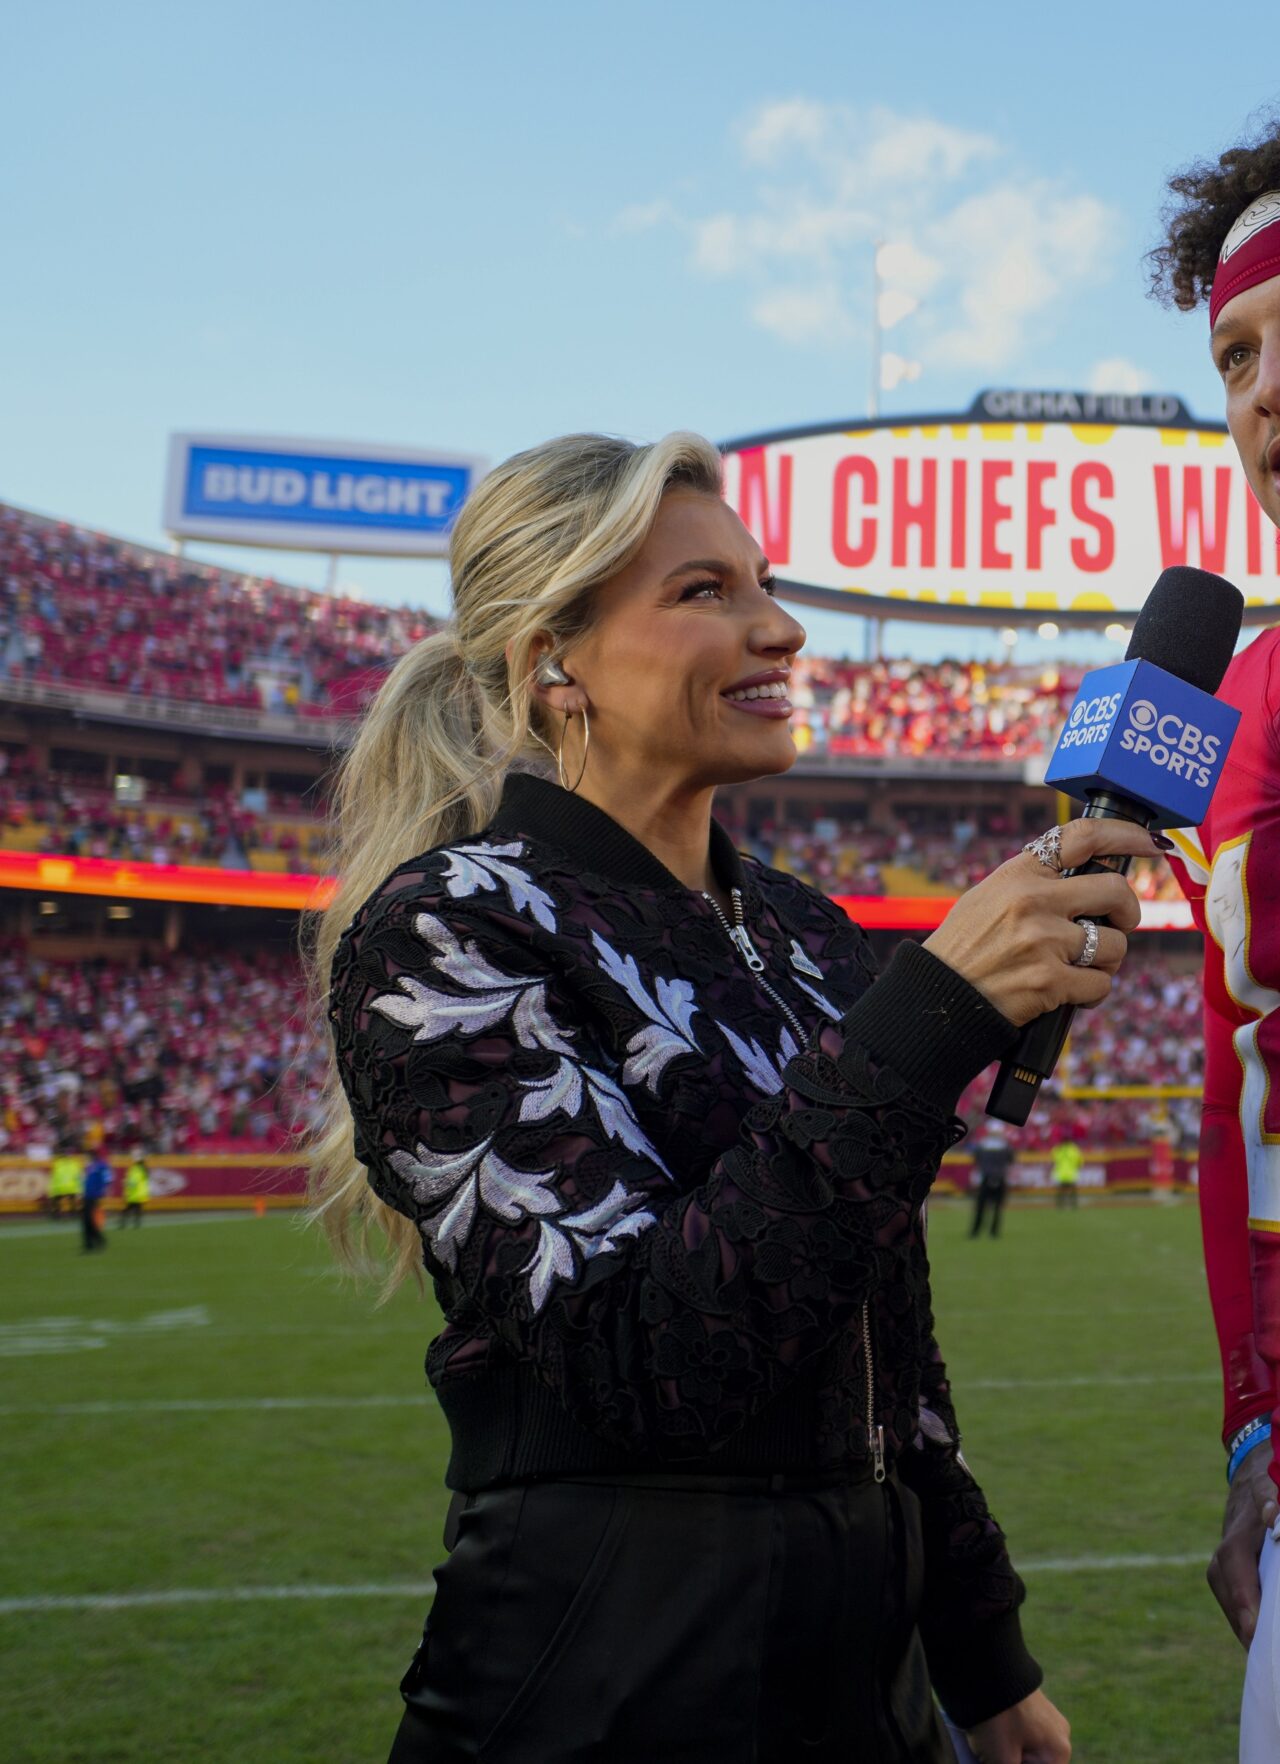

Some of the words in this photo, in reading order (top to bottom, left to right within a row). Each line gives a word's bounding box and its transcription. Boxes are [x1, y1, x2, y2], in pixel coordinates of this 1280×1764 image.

[983, 387, 1081, 419] GEHA
[1082, 392, 1180, 422] FIELD
[203, 462, 307, 505] BUD
[311, 472, 452, 517] LIGHT
[832, 454, 1116, 574] CHIEFS
[1083, 692, 1122, 726] CBS
[1060, 722, 1111, 750] SPORTS
[1119, 728, 1212, 789] SPORTS
[1156, 714, 1222, 765] CBS
